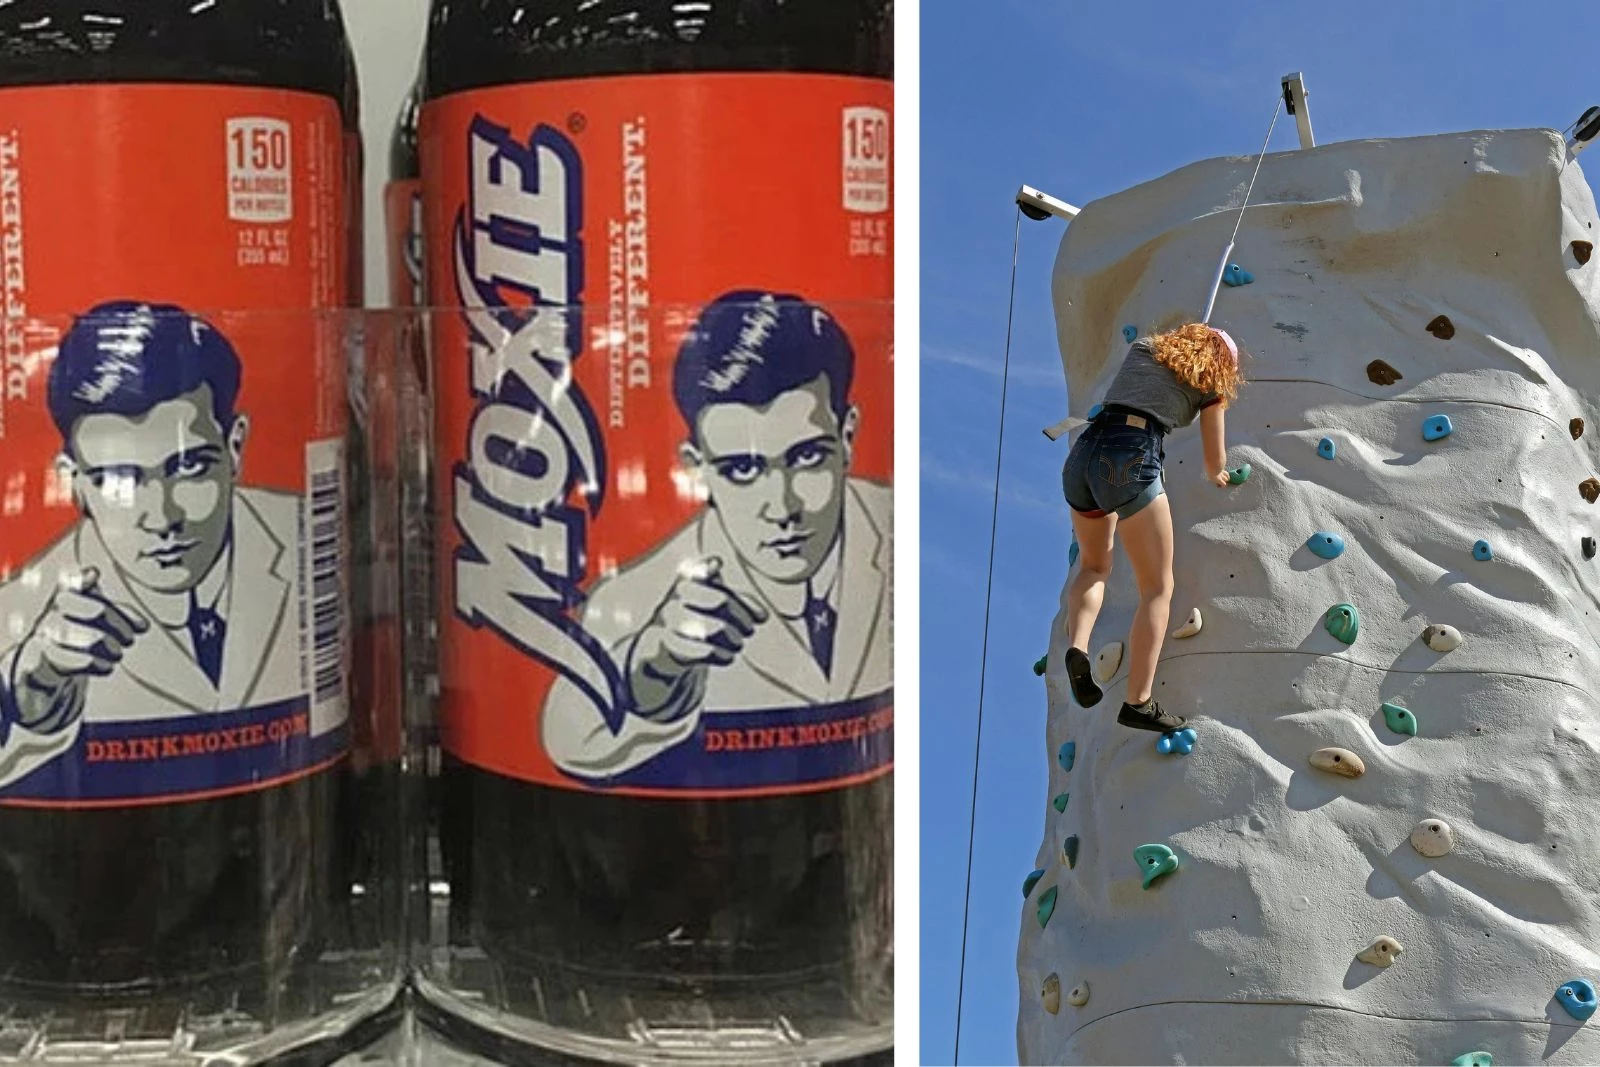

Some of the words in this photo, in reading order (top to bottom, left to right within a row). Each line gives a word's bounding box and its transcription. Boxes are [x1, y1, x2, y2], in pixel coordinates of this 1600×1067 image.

[231, 127, 286, 169] 150
[847, 117, 885, 160] 150
[622, 116, 650, 389] DIFFERENT.
[453, 114, 622, 736] MOXIE
